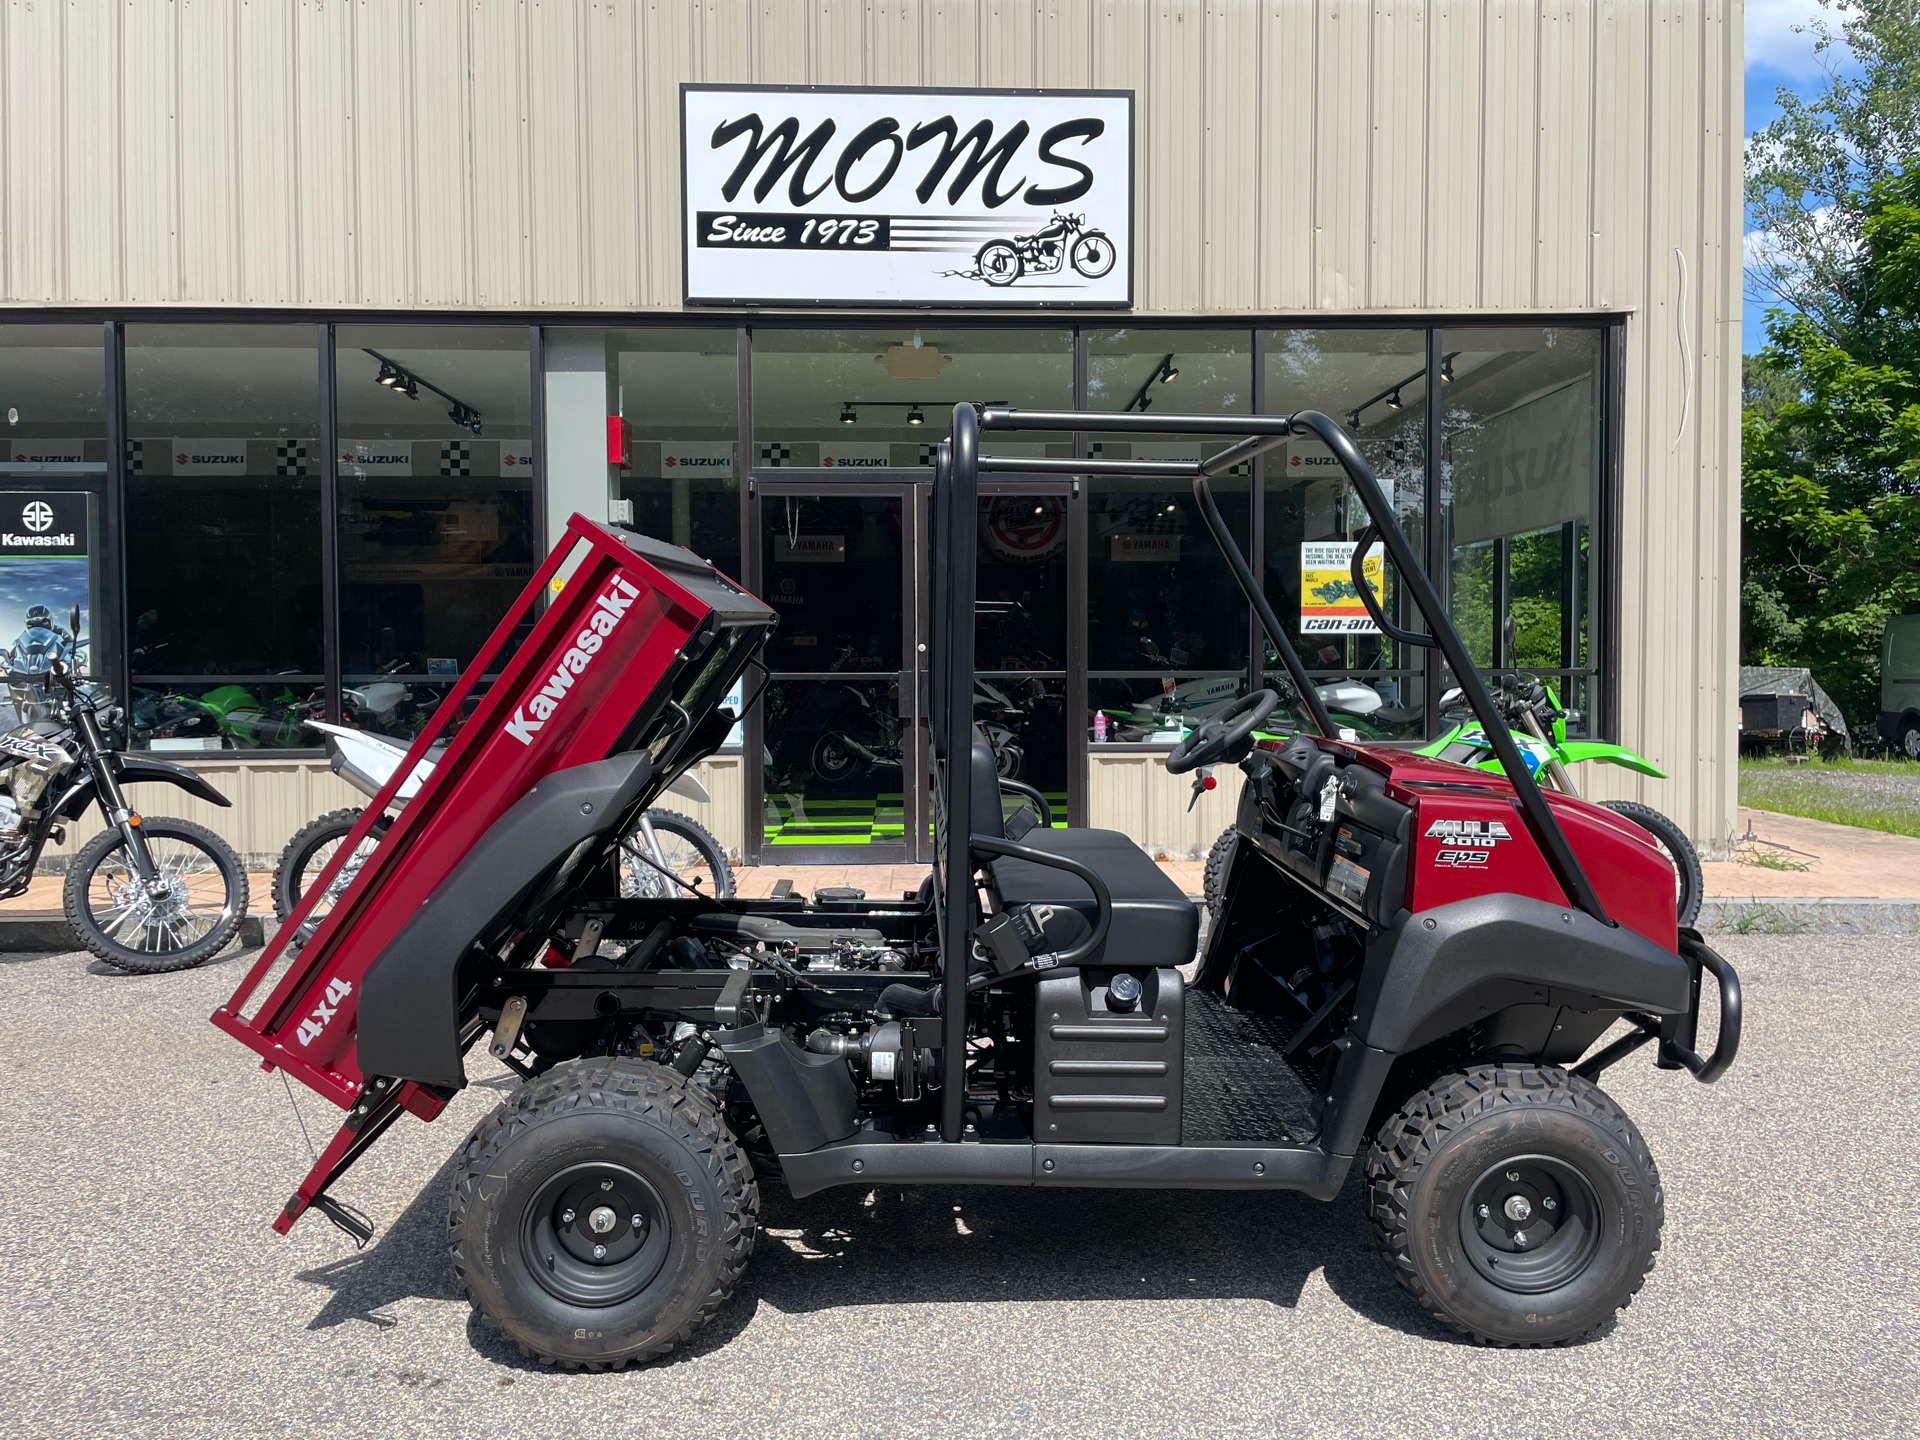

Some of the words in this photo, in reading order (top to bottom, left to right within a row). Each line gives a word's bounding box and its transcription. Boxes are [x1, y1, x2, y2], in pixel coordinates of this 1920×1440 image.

[711, 113, 1105, 208] MOMS
[707, 215, 786, 243] Since
[800, 218, 880, 245] 1973
[192, 455, 244, 464] SUZUKI
[357, 455, 409, 464] SUZUKI
[680, 458, 730, 466] SUZUKI
[837, 458, 887, 467] SUZUKI
[1305, 457, 1341, 465] SUZU
[2, 533, 75, 546] Kawasaki
[797, 540, 835, 550] YAMAHA
[1133, 540, 1170, 550] YAMAHA
[505, 567, 534, 576] YAMAH
[770, 593, 804, 605] YAMAHA
[1305, 619, 1378, 630] can-am
[503, 574, 640, 746] Kawasaki
[1206, 683, 1235, 695] YAMAHA
[1424, 820, 1512, 840] MULE
[1441, 838, 1496, 847] 4010
[296, 977, 352, 1047] 4x4
[674, 1169, 709, 1262] DURO
